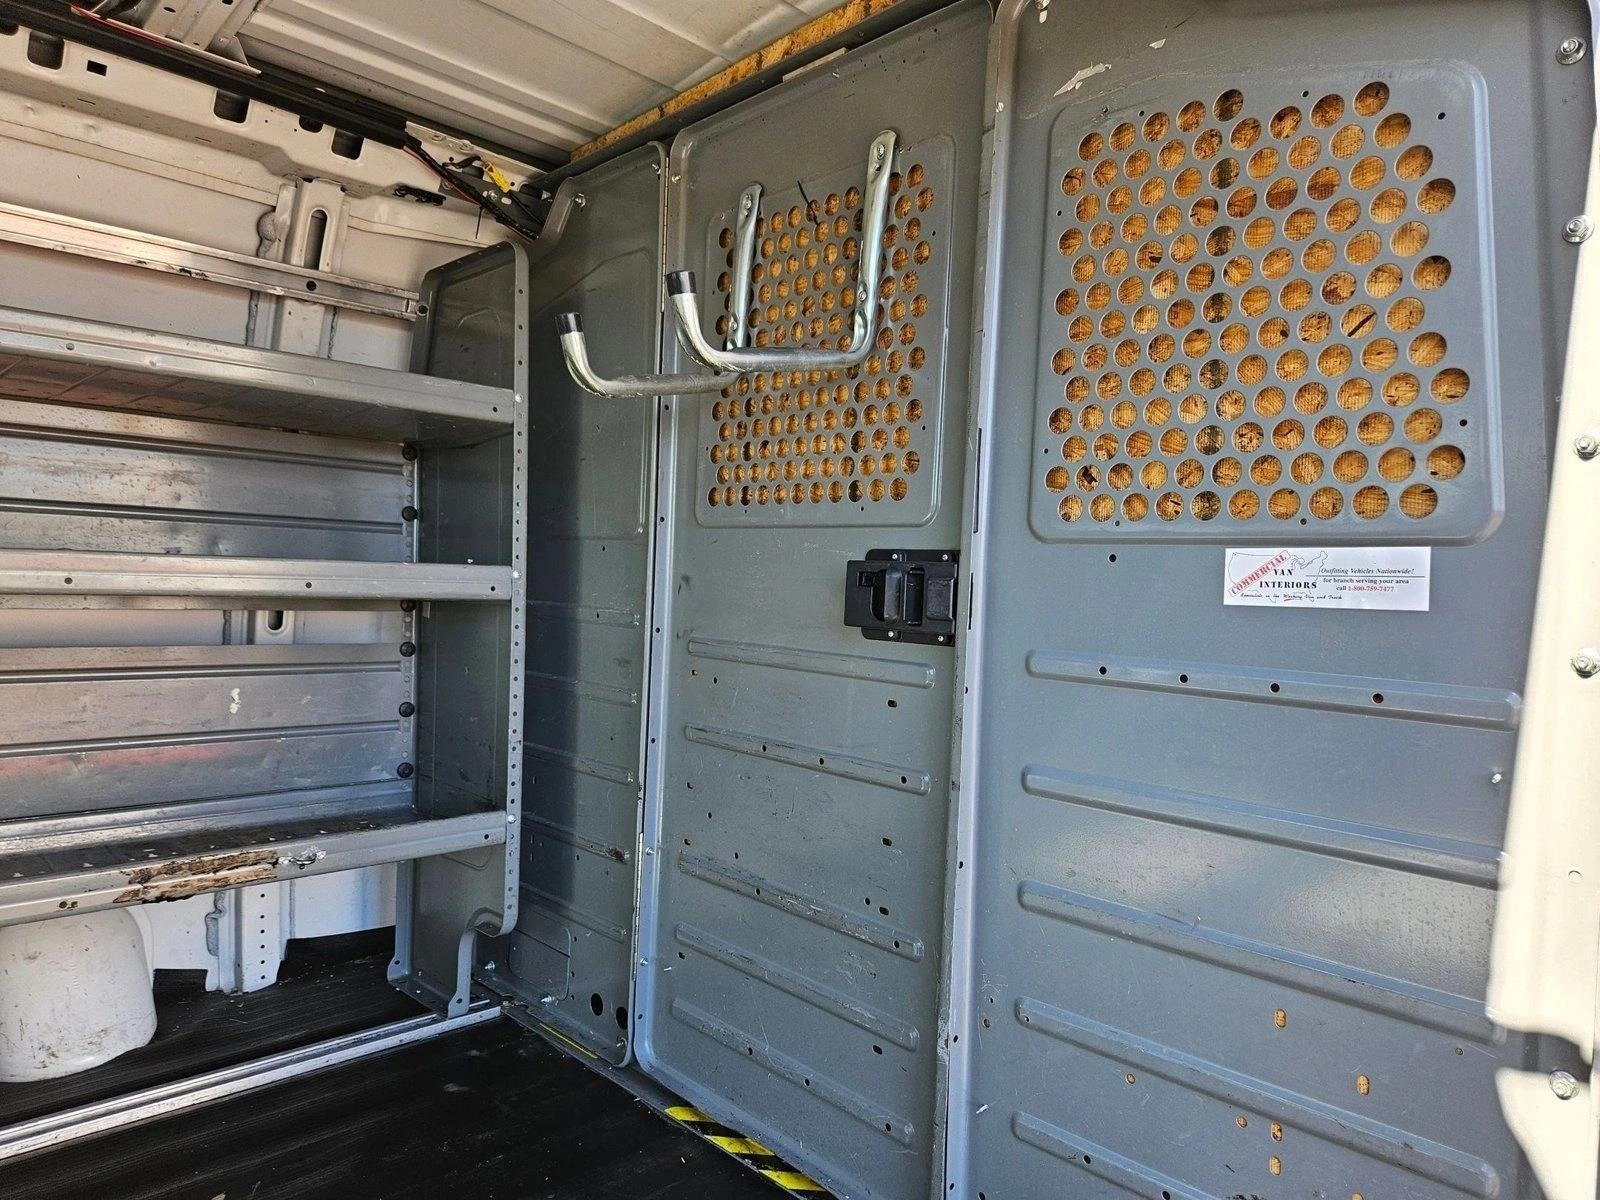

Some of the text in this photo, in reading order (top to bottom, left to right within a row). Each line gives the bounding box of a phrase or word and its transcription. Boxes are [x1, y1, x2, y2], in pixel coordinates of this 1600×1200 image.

[1231, 554, 1287, 595] COMMERCIAL
[1274, 568, 1293, 576] VAN
[1260, 581, 1317, 589] INTERIORS
